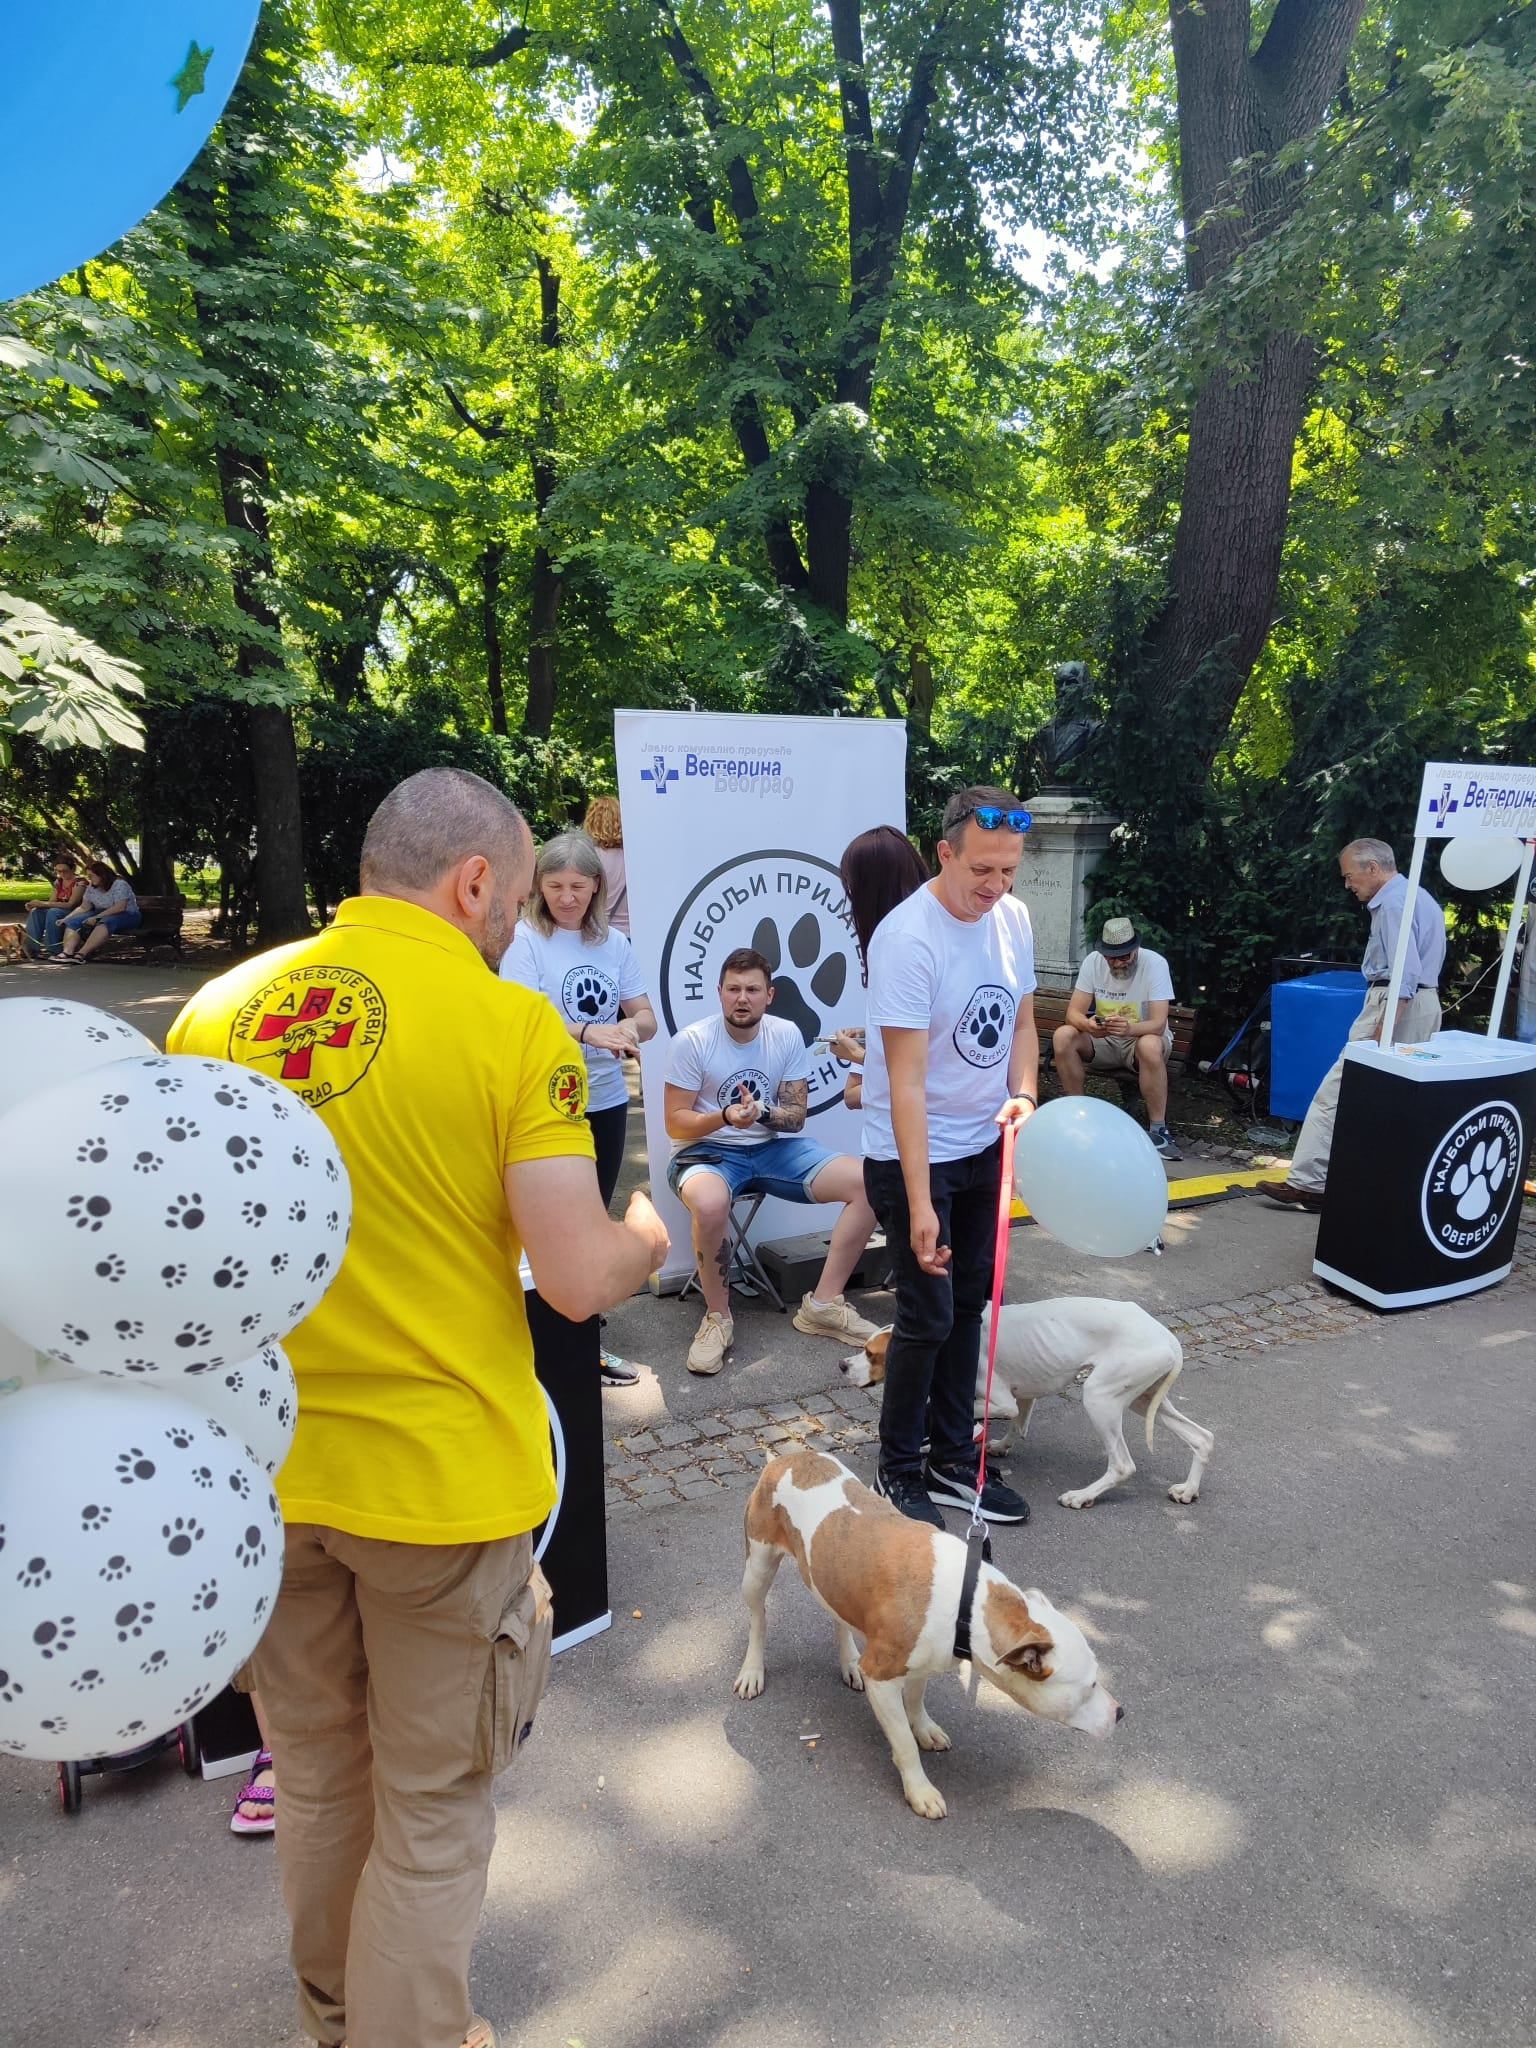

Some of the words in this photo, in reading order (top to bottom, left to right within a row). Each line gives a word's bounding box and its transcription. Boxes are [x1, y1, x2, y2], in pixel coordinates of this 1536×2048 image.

[640, 743, 674, 753] Јавно
[677, 744, 735, 756] комунално
[685, 753, 782, 779] Ветерина
[714, 770, 794, 800] Београд
[1481, 804, 1536, 835] Београ
[684, 873, 768, 1000] НАЈБОЉИ
[236, 983, 284, 1040] ANIMAL
[290, 969, 363, 989] RESCUE
[358, 986, 381, 1046] SERBIA
[1433, 1115, 1486, 1193] НАЈБОЉИ
[1489, 1113, 1517, 1178] ПРИЈАТЕЉ
[1441, 1212, 1498, 1246] ОВЕРЕНО
